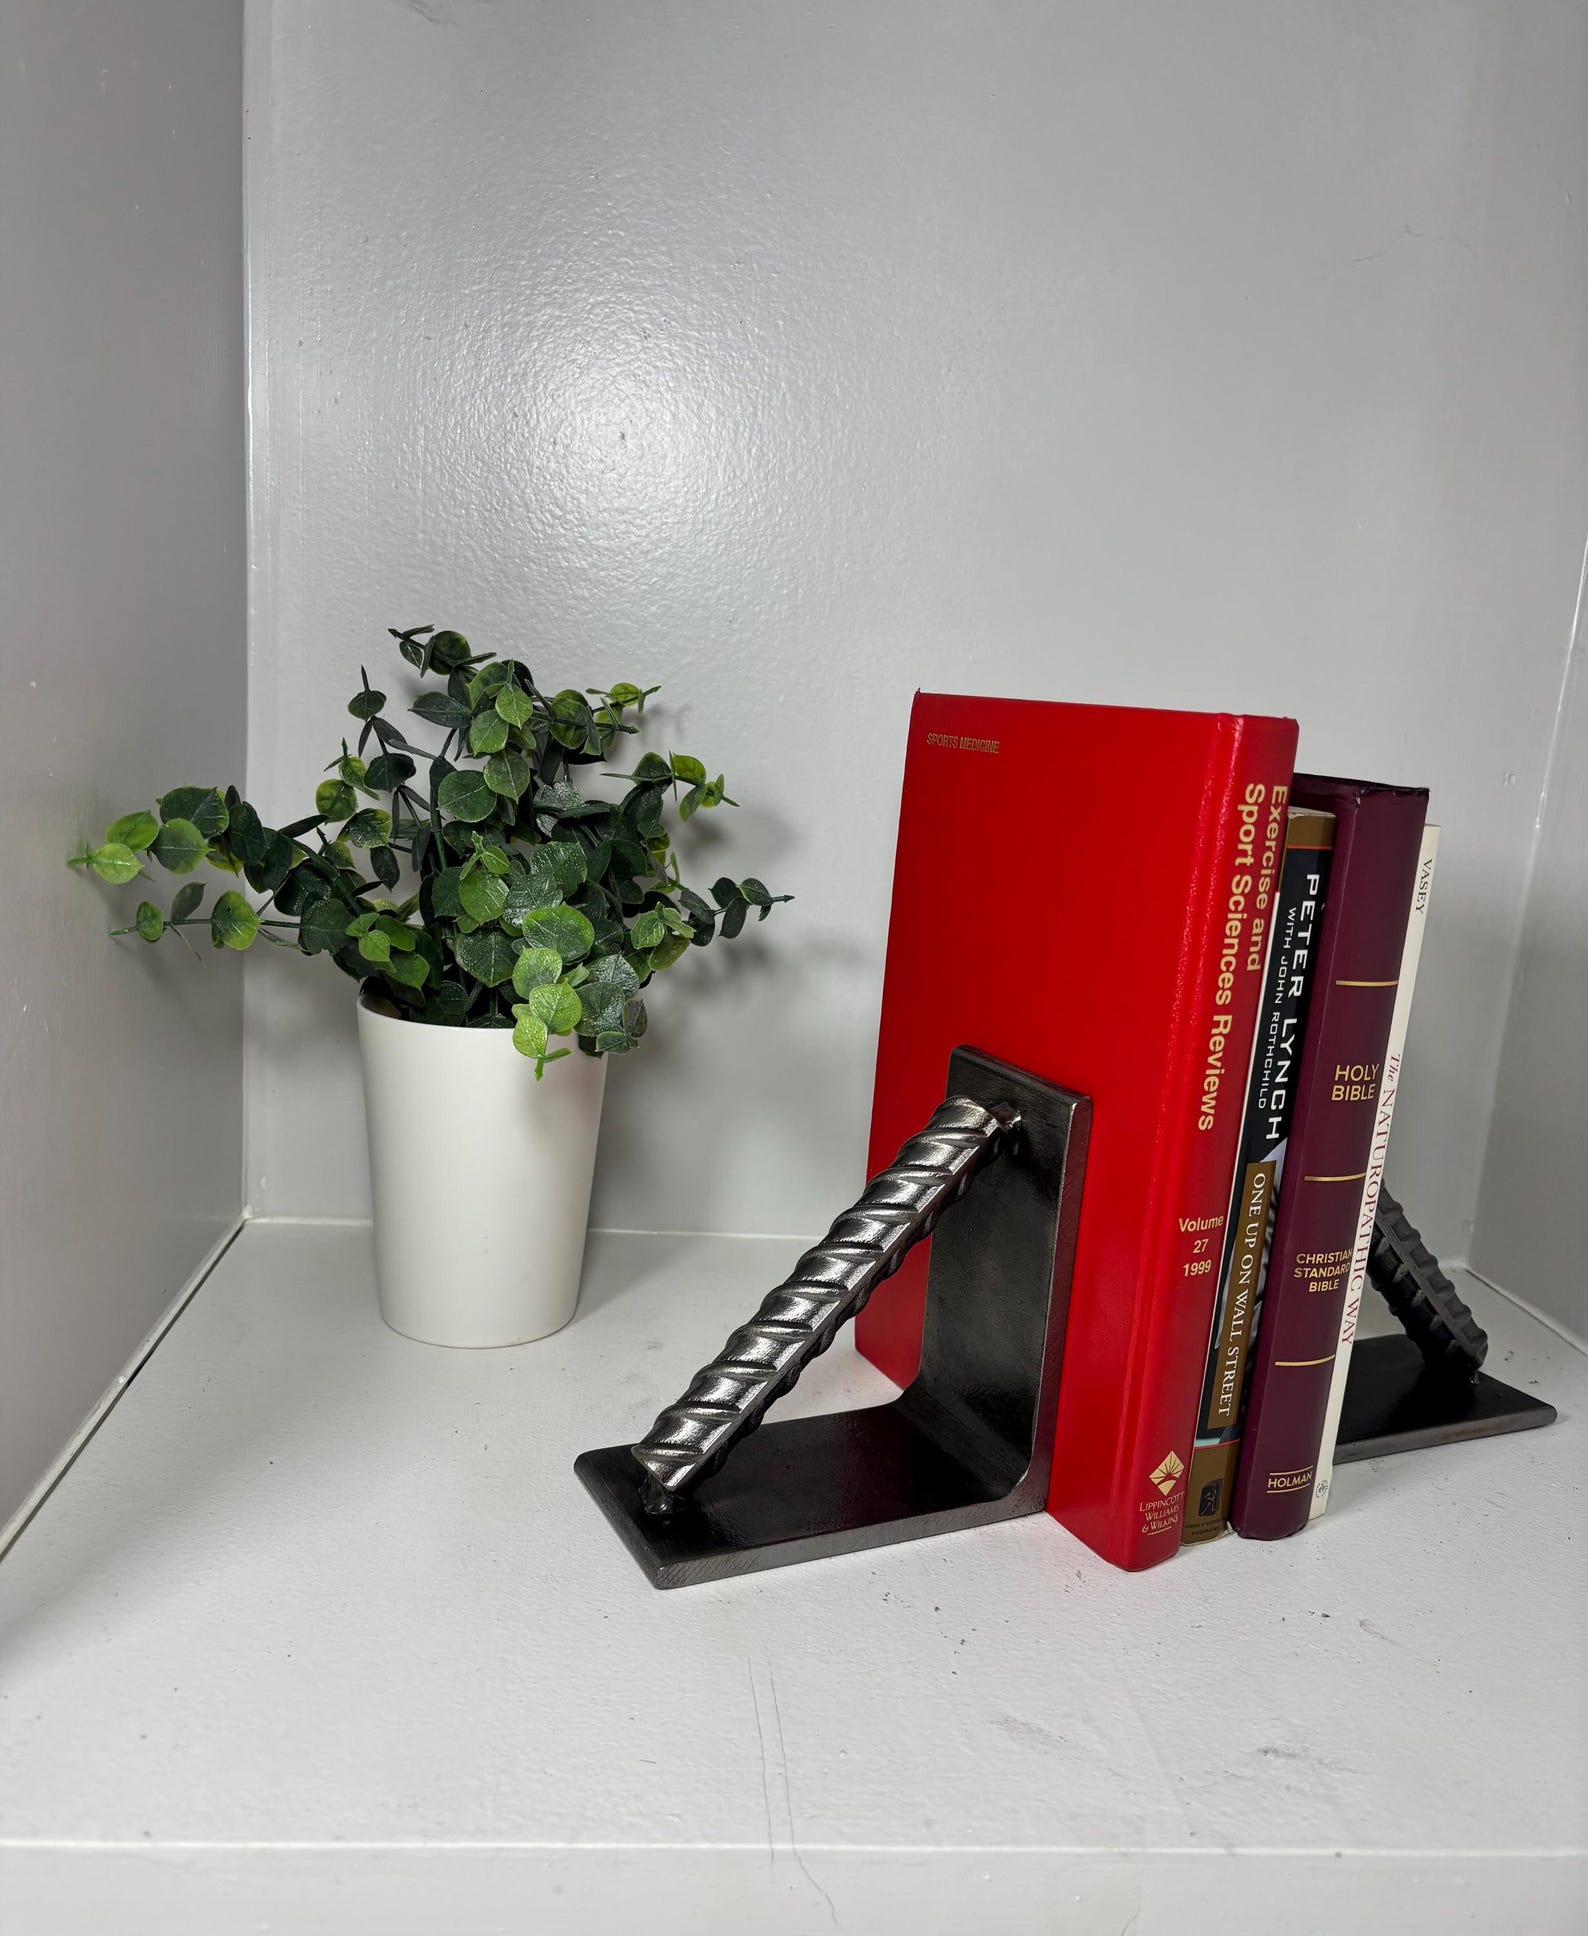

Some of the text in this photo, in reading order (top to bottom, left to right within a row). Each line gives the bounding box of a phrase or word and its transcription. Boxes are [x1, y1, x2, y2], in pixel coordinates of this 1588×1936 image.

[927, 733, 1000, 754] SPORTS MEDICINE
[1246, 785, 1288, 971] Exercise and
[1415, 858, 1433, 914] VASEY
[1198, 784, 1266, 1131] Sport Sciences Reviews
[1258, 907, 1297, 1109] WITH JOHN ROTHCHILD
[1266, 874, 1320, 1140] PETER LYNCH
[1334, 1063, 1380, 1082] HOLY
[1331, 1083, 1376, 1101] BIBLE
[1342, 1054, 1401, 1344] The NATUROPATHIC WAY
[1178, 1215, 1224, 1232] Volume
[1193, 1238, 1209, 1253] 27
[1296, 1247, 1354, 1264] CHRISTIAN
[1183, 1259, 1212, 1277] 1999
[1293, 1262, 1351, 1278] STANDARD
[1218, 1173, 1266, 1416] ONE UP ON WALL STREET
[1308, 1279, 1340, 1292] BIBLE
[1267, 1471, 1313, 1488] HOLMAN
